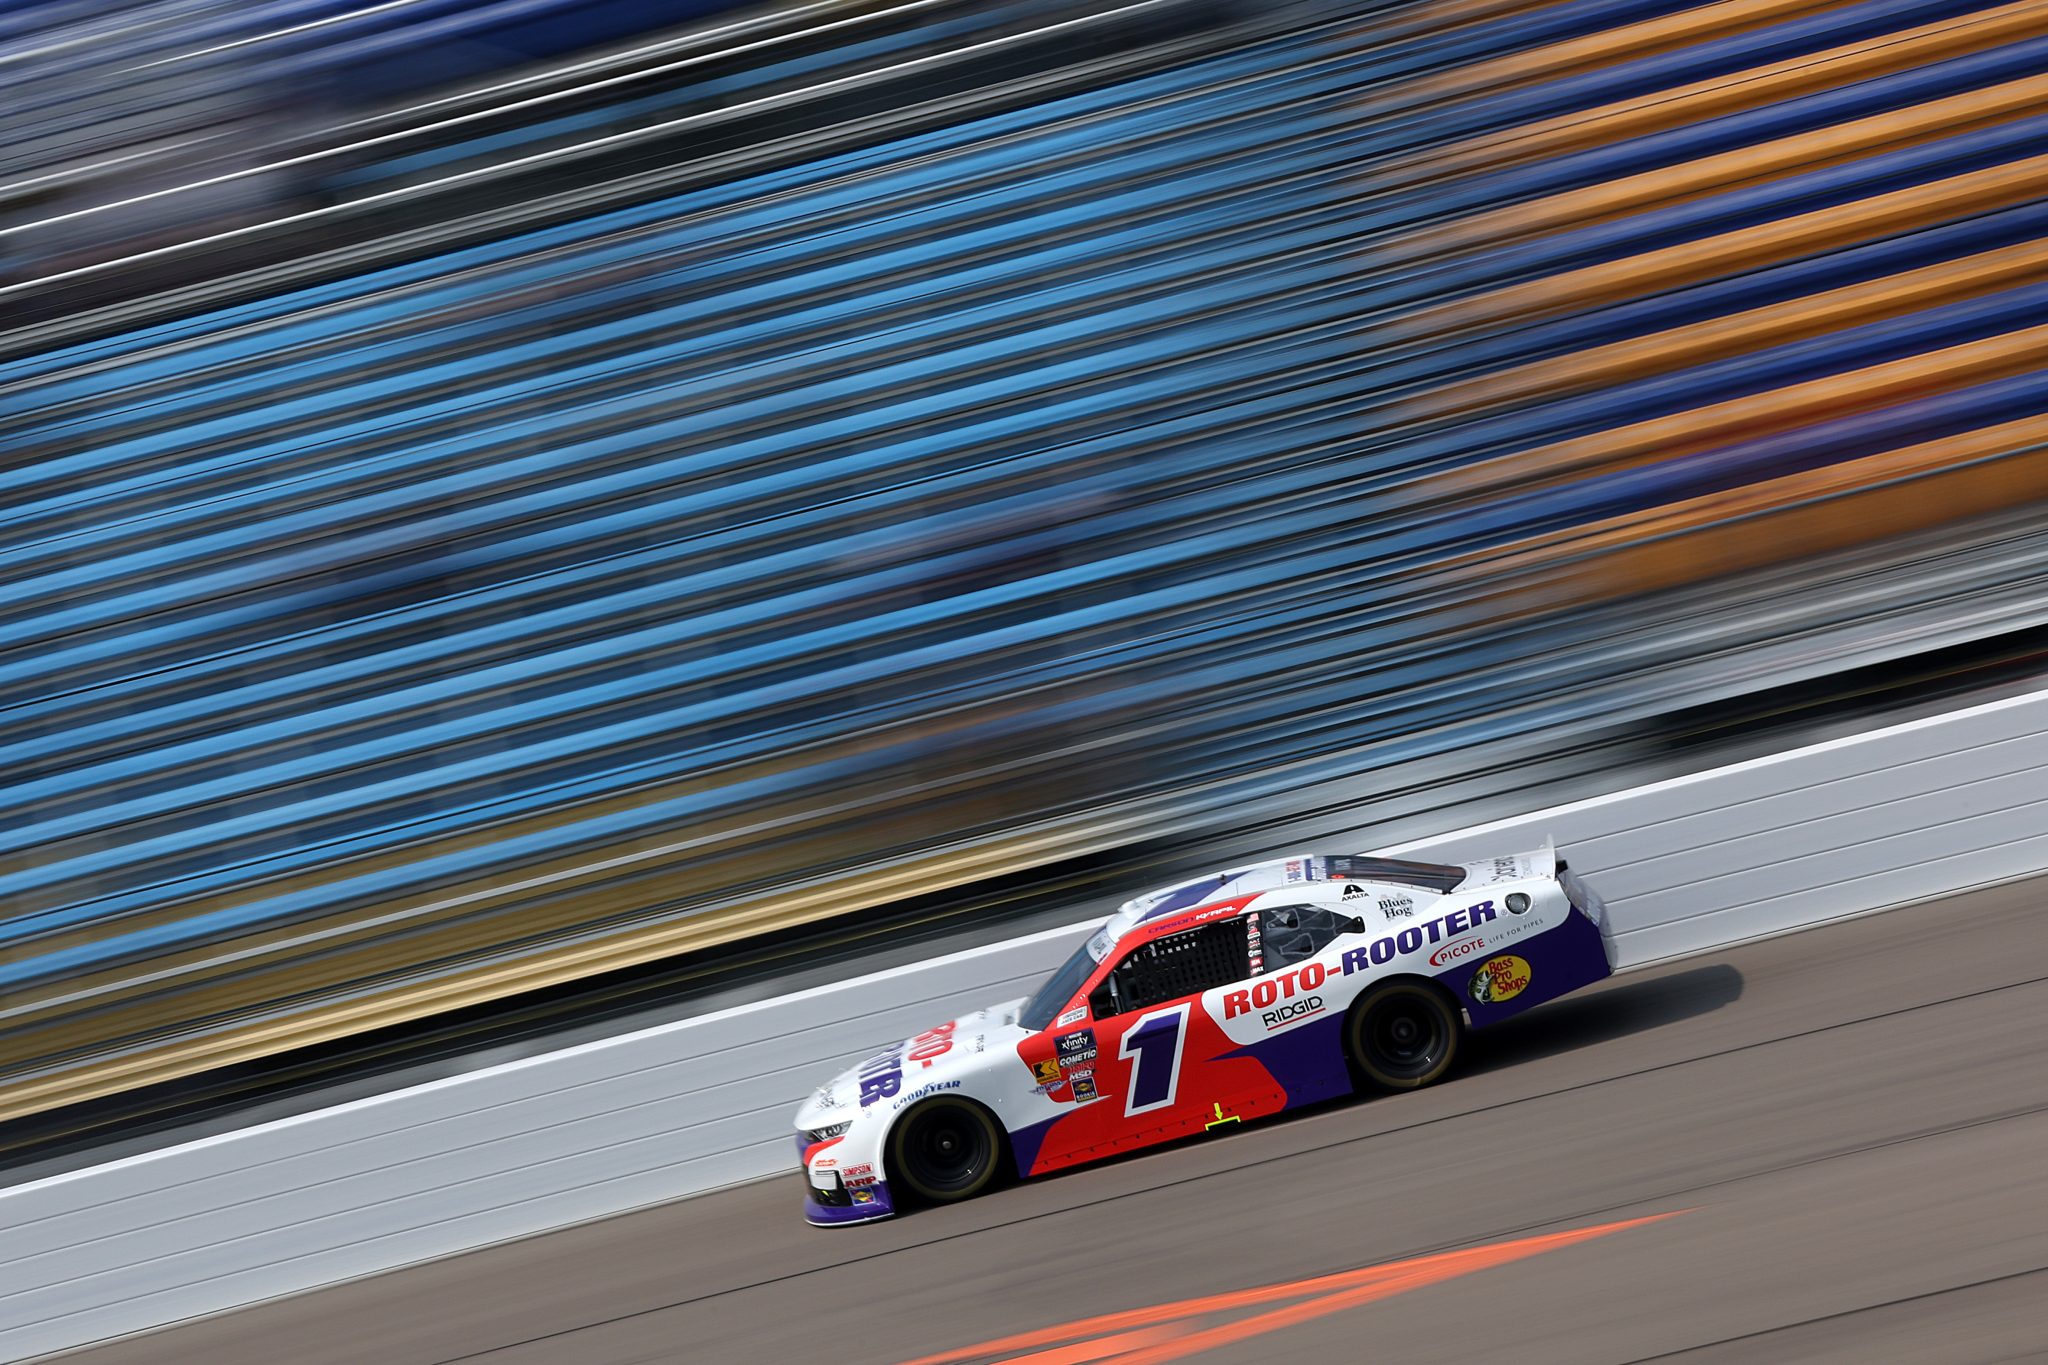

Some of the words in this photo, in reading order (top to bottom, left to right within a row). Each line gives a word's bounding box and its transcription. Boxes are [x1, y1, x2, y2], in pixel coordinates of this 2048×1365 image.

[1342, 892, 1370, 902] AXALTA
[1378, 897, 1413, 910] Blues
[1384, 907, 1412, 919] Hog
[1441, 938, 1485, 962] PICOTE
[1489, 934, 1504, 943] LIFE
[1507, 927, 1521, 936] FOR
[1523, 918, 1544, 931] PIPES
[1223, 900, 1497, 1020] ROTO-ROOTER
[1488, 957, 1514, 975] Bass
[1494, 970, 1512, 985] Pro
[1497, 975, 1527, 995] Shops
[1262, 995, 1324, 1027] RIDGID
[1062, 1036, 1088, 1050] xfinity
[1060, 1049, 1096, 1066] COMETIC
[1118, 1001, 1192, 1118] 1
[1069, 1069, 1092, 1082] MSD
[893, 1080, 961, 1110] GOODYEAR
[842, 1163, 872, 1177] SIMPSON
[845, 1176, 877, 1188] ARP
